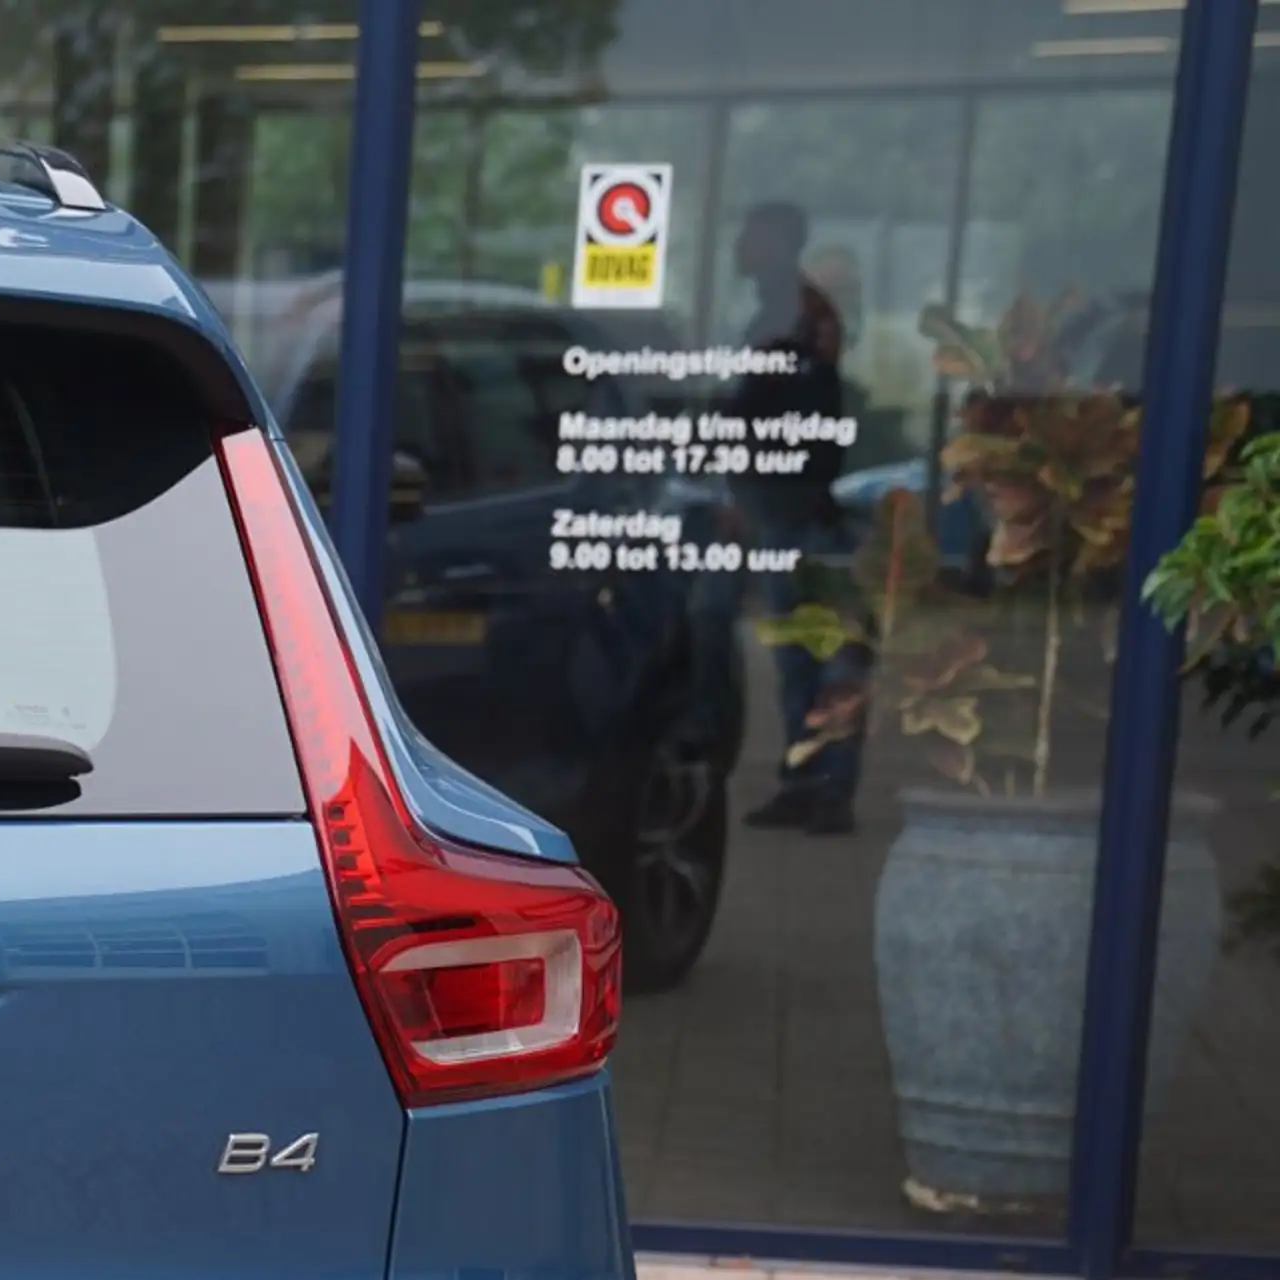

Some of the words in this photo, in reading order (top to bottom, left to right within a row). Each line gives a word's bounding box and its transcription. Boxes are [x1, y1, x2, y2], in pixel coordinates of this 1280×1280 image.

[562, 346, 799, 380] Openingstijden:
[558, 412, 693, 445] Maandag
[697, 414, 746, 440] t/m
[752, 412, 857, 446] vrijdag
[555, 445, 618, 473] 8.00
[623, 447, 665, 473] tot
[672, 445, 750, 474] 17.30
[754, 450, 809, 473] uur
[550, 509, 683, 543] Zaterdag
[549, 542, 611, 570] 9.00
[615, 544, 658, 570] tot
[665, 543, 742, 571] 13.00
[746, 549, 801, 571] uur
[218, 1132, 319, 1173] B4
